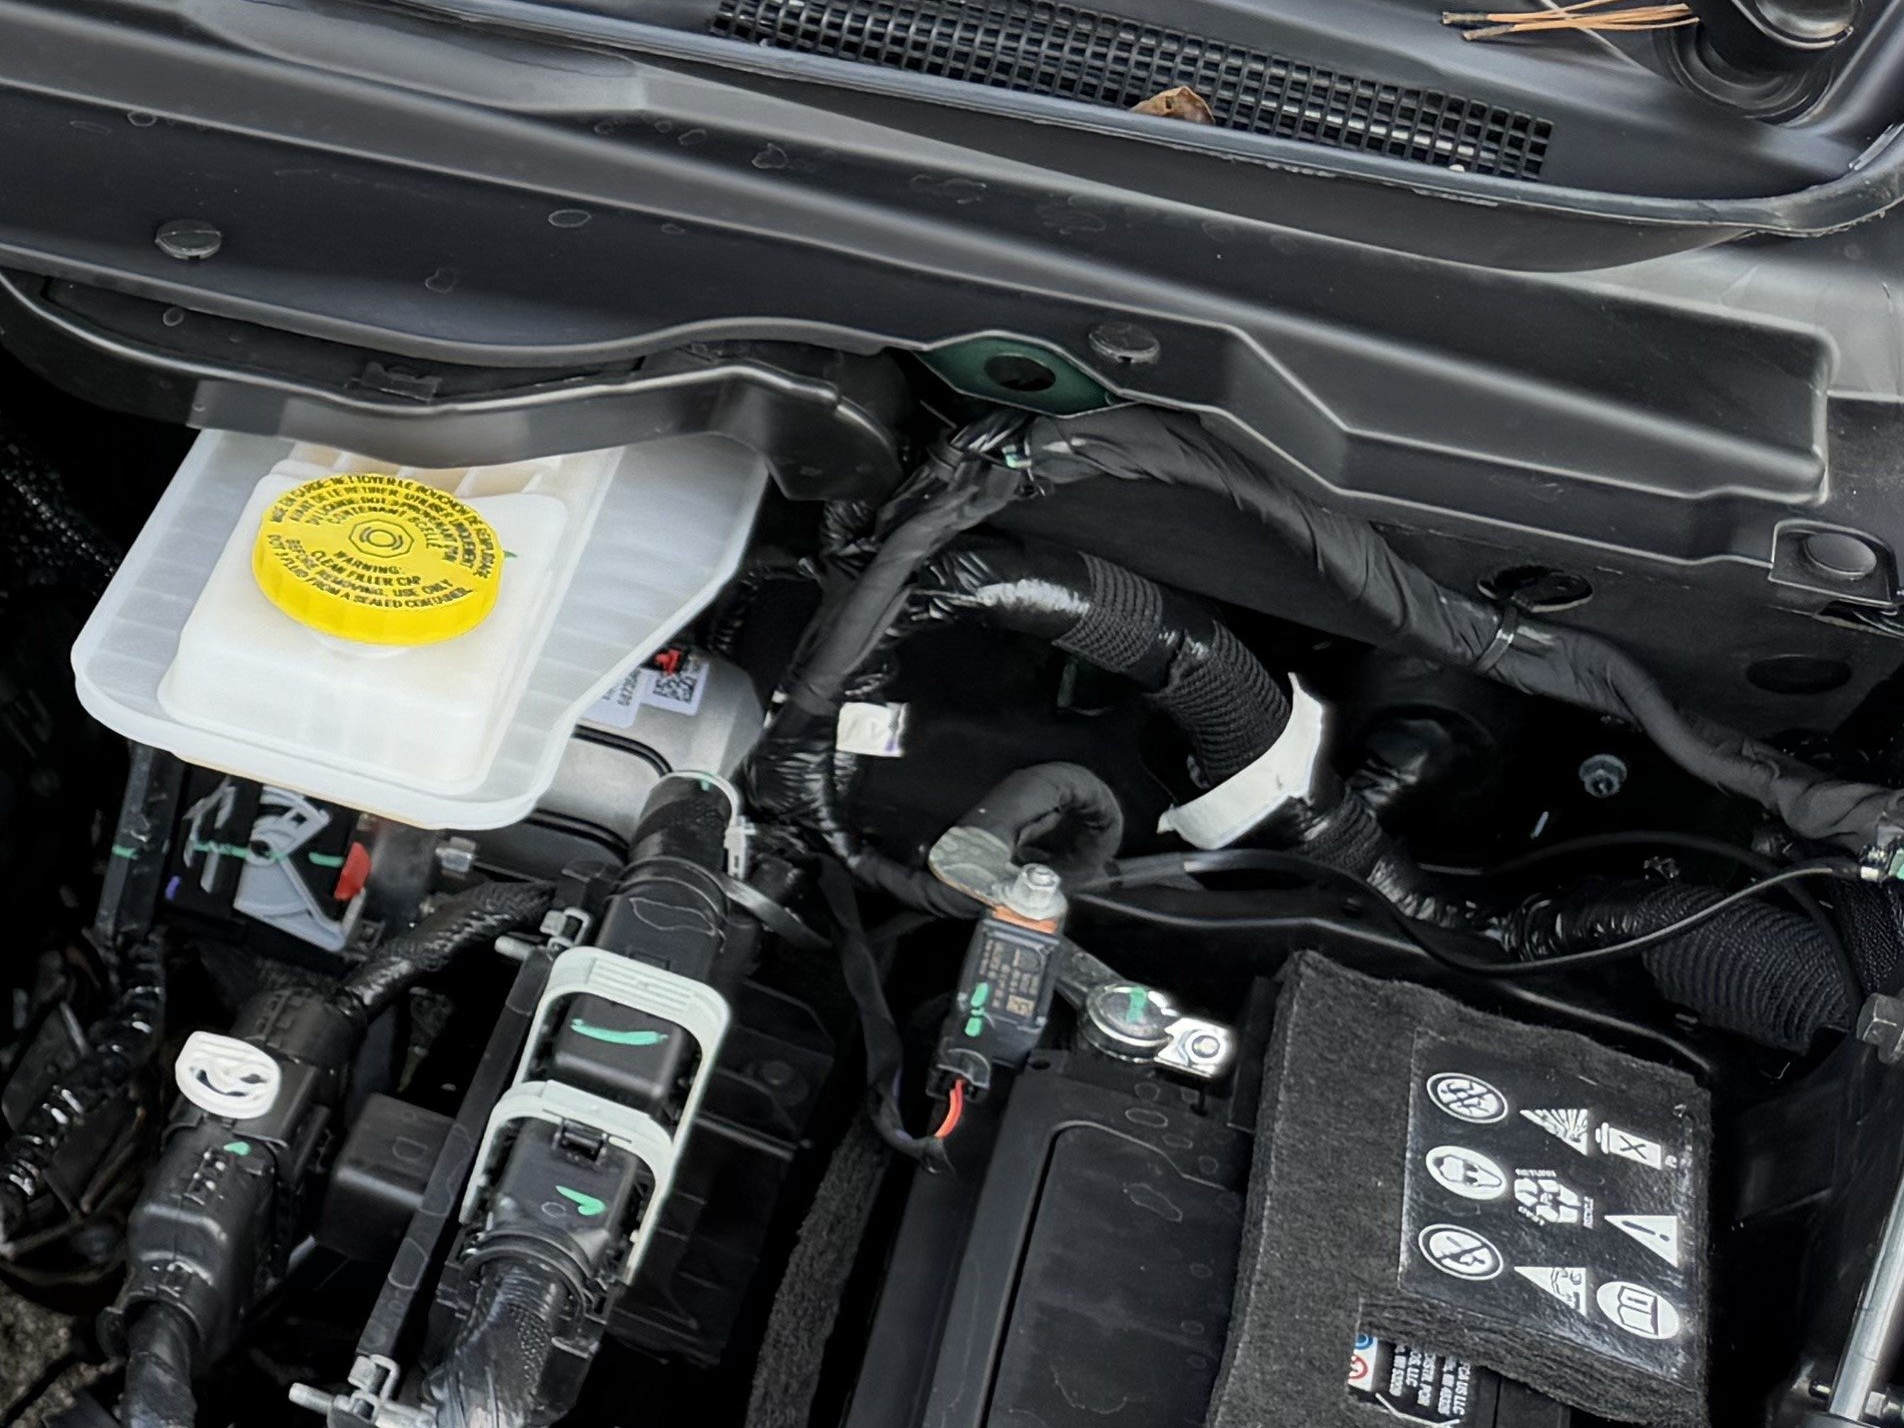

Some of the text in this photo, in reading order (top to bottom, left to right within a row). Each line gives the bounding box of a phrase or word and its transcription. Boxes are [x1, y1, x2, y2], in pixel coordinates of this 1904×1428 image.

[308, 549, 425, 586] CLEAN FILLER CAP
[302, 576, 341, 597] FROM
[351, 594, 403, 607] SEALED
[392, 588, 419, 597] USE
[419, 578, 456, 595] ONLY
[1405, 1366, 1420, 1388] LLC
[1452, 1395, 1467, 1415] LLC
